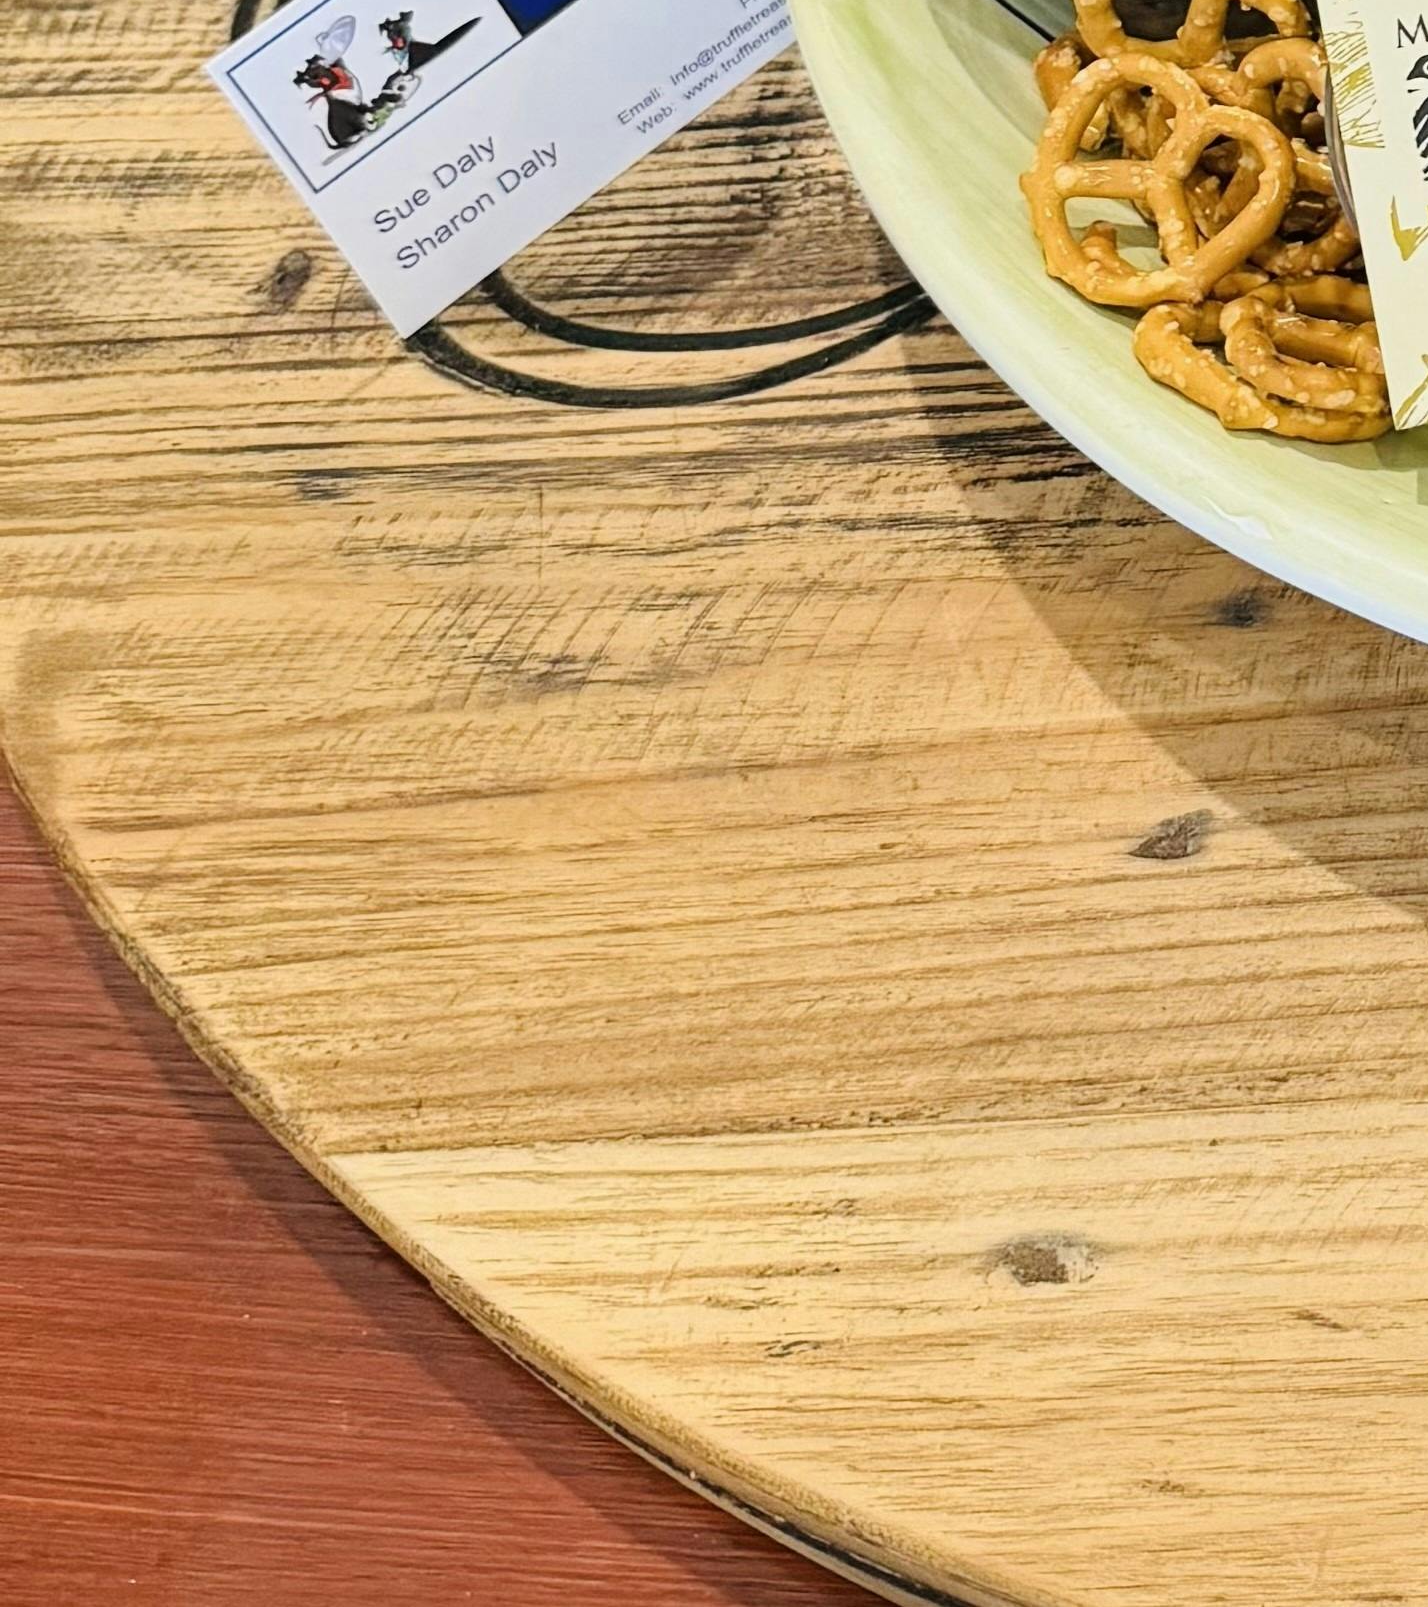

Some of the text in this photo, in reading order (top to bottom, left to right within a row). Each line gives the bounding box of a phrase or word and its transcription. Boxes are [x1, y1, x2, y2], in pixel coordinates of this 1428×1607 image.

[616, 86, 664, 127] Email:
[636, 103, 676, 135] Web:
[373, 135, 497, 234] Sue Daly
[396, 141, 558, 270] Sharon Daly
